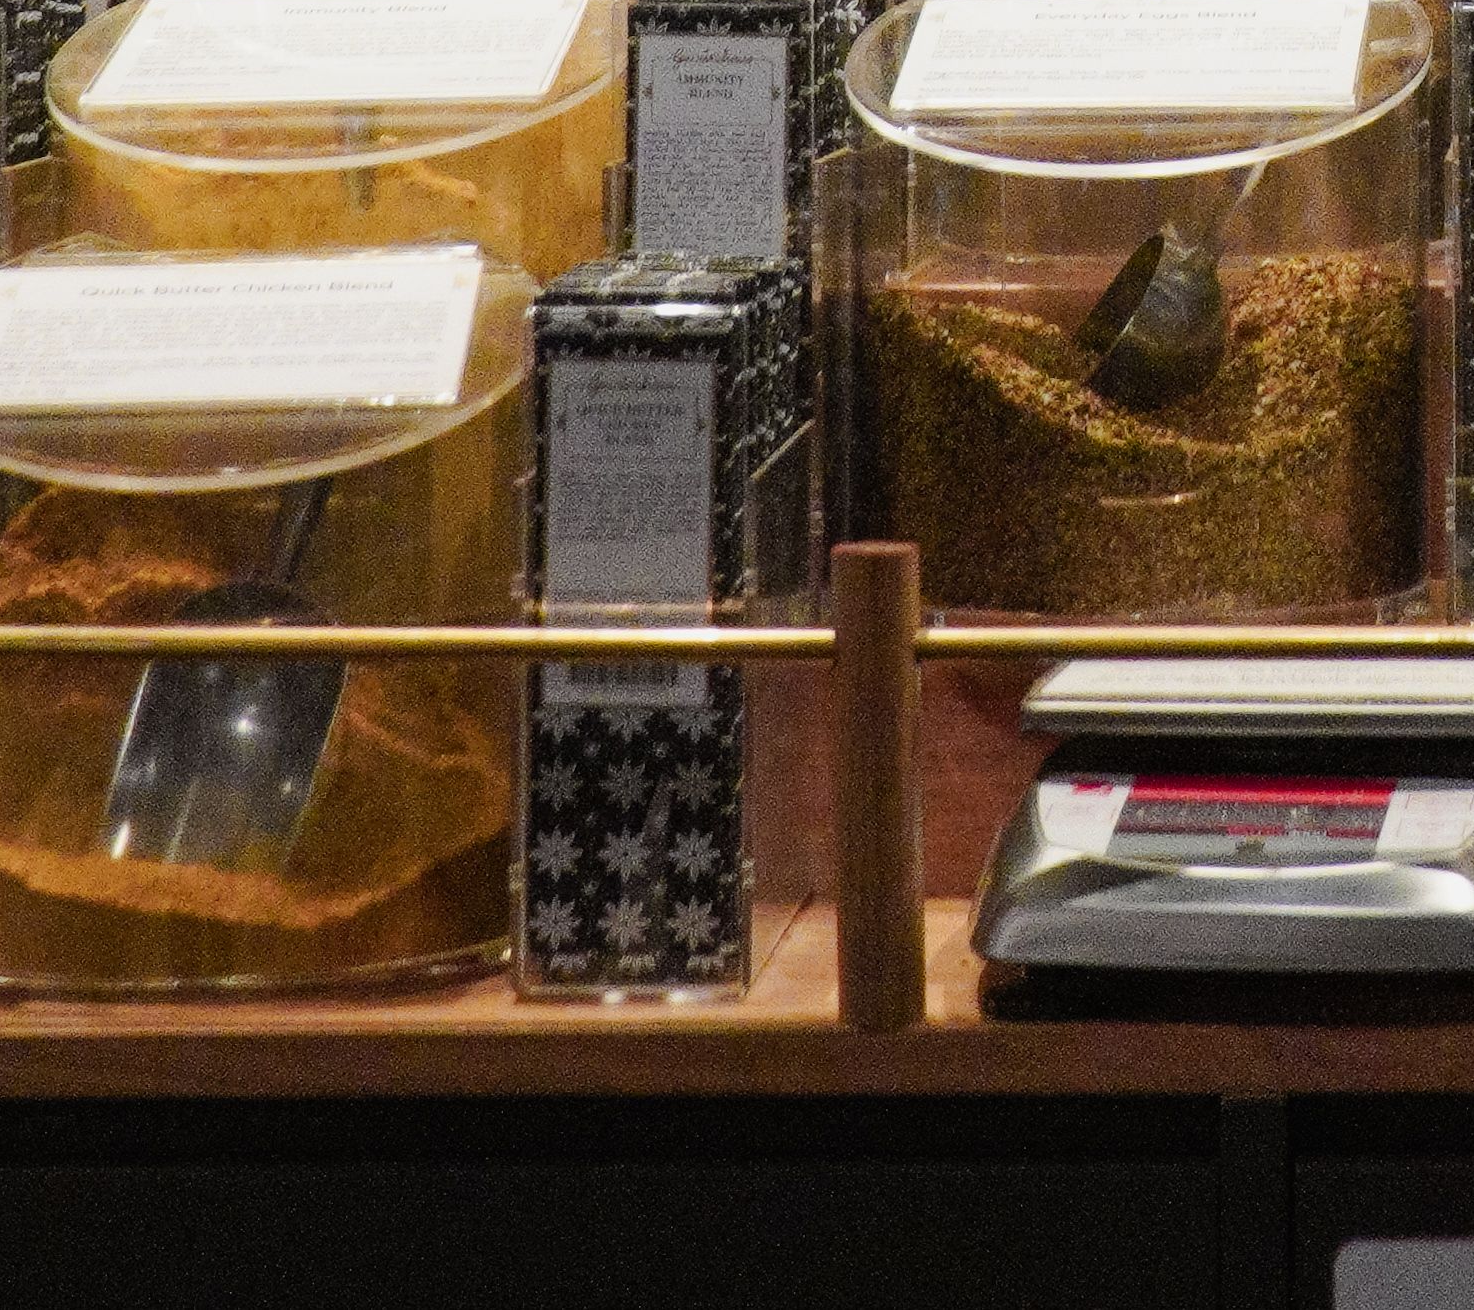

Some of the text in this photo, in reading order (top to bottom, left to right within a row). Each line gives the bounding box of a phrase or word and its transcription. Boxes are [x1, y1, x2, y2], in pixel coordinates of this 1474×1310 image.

[283, 3, 447, 16] Immunity Blend
[1034, 8, 1257, 22] Everyday Eggs Blend
[79, 281, 395, 297] Quick Butter Chicken Blend
